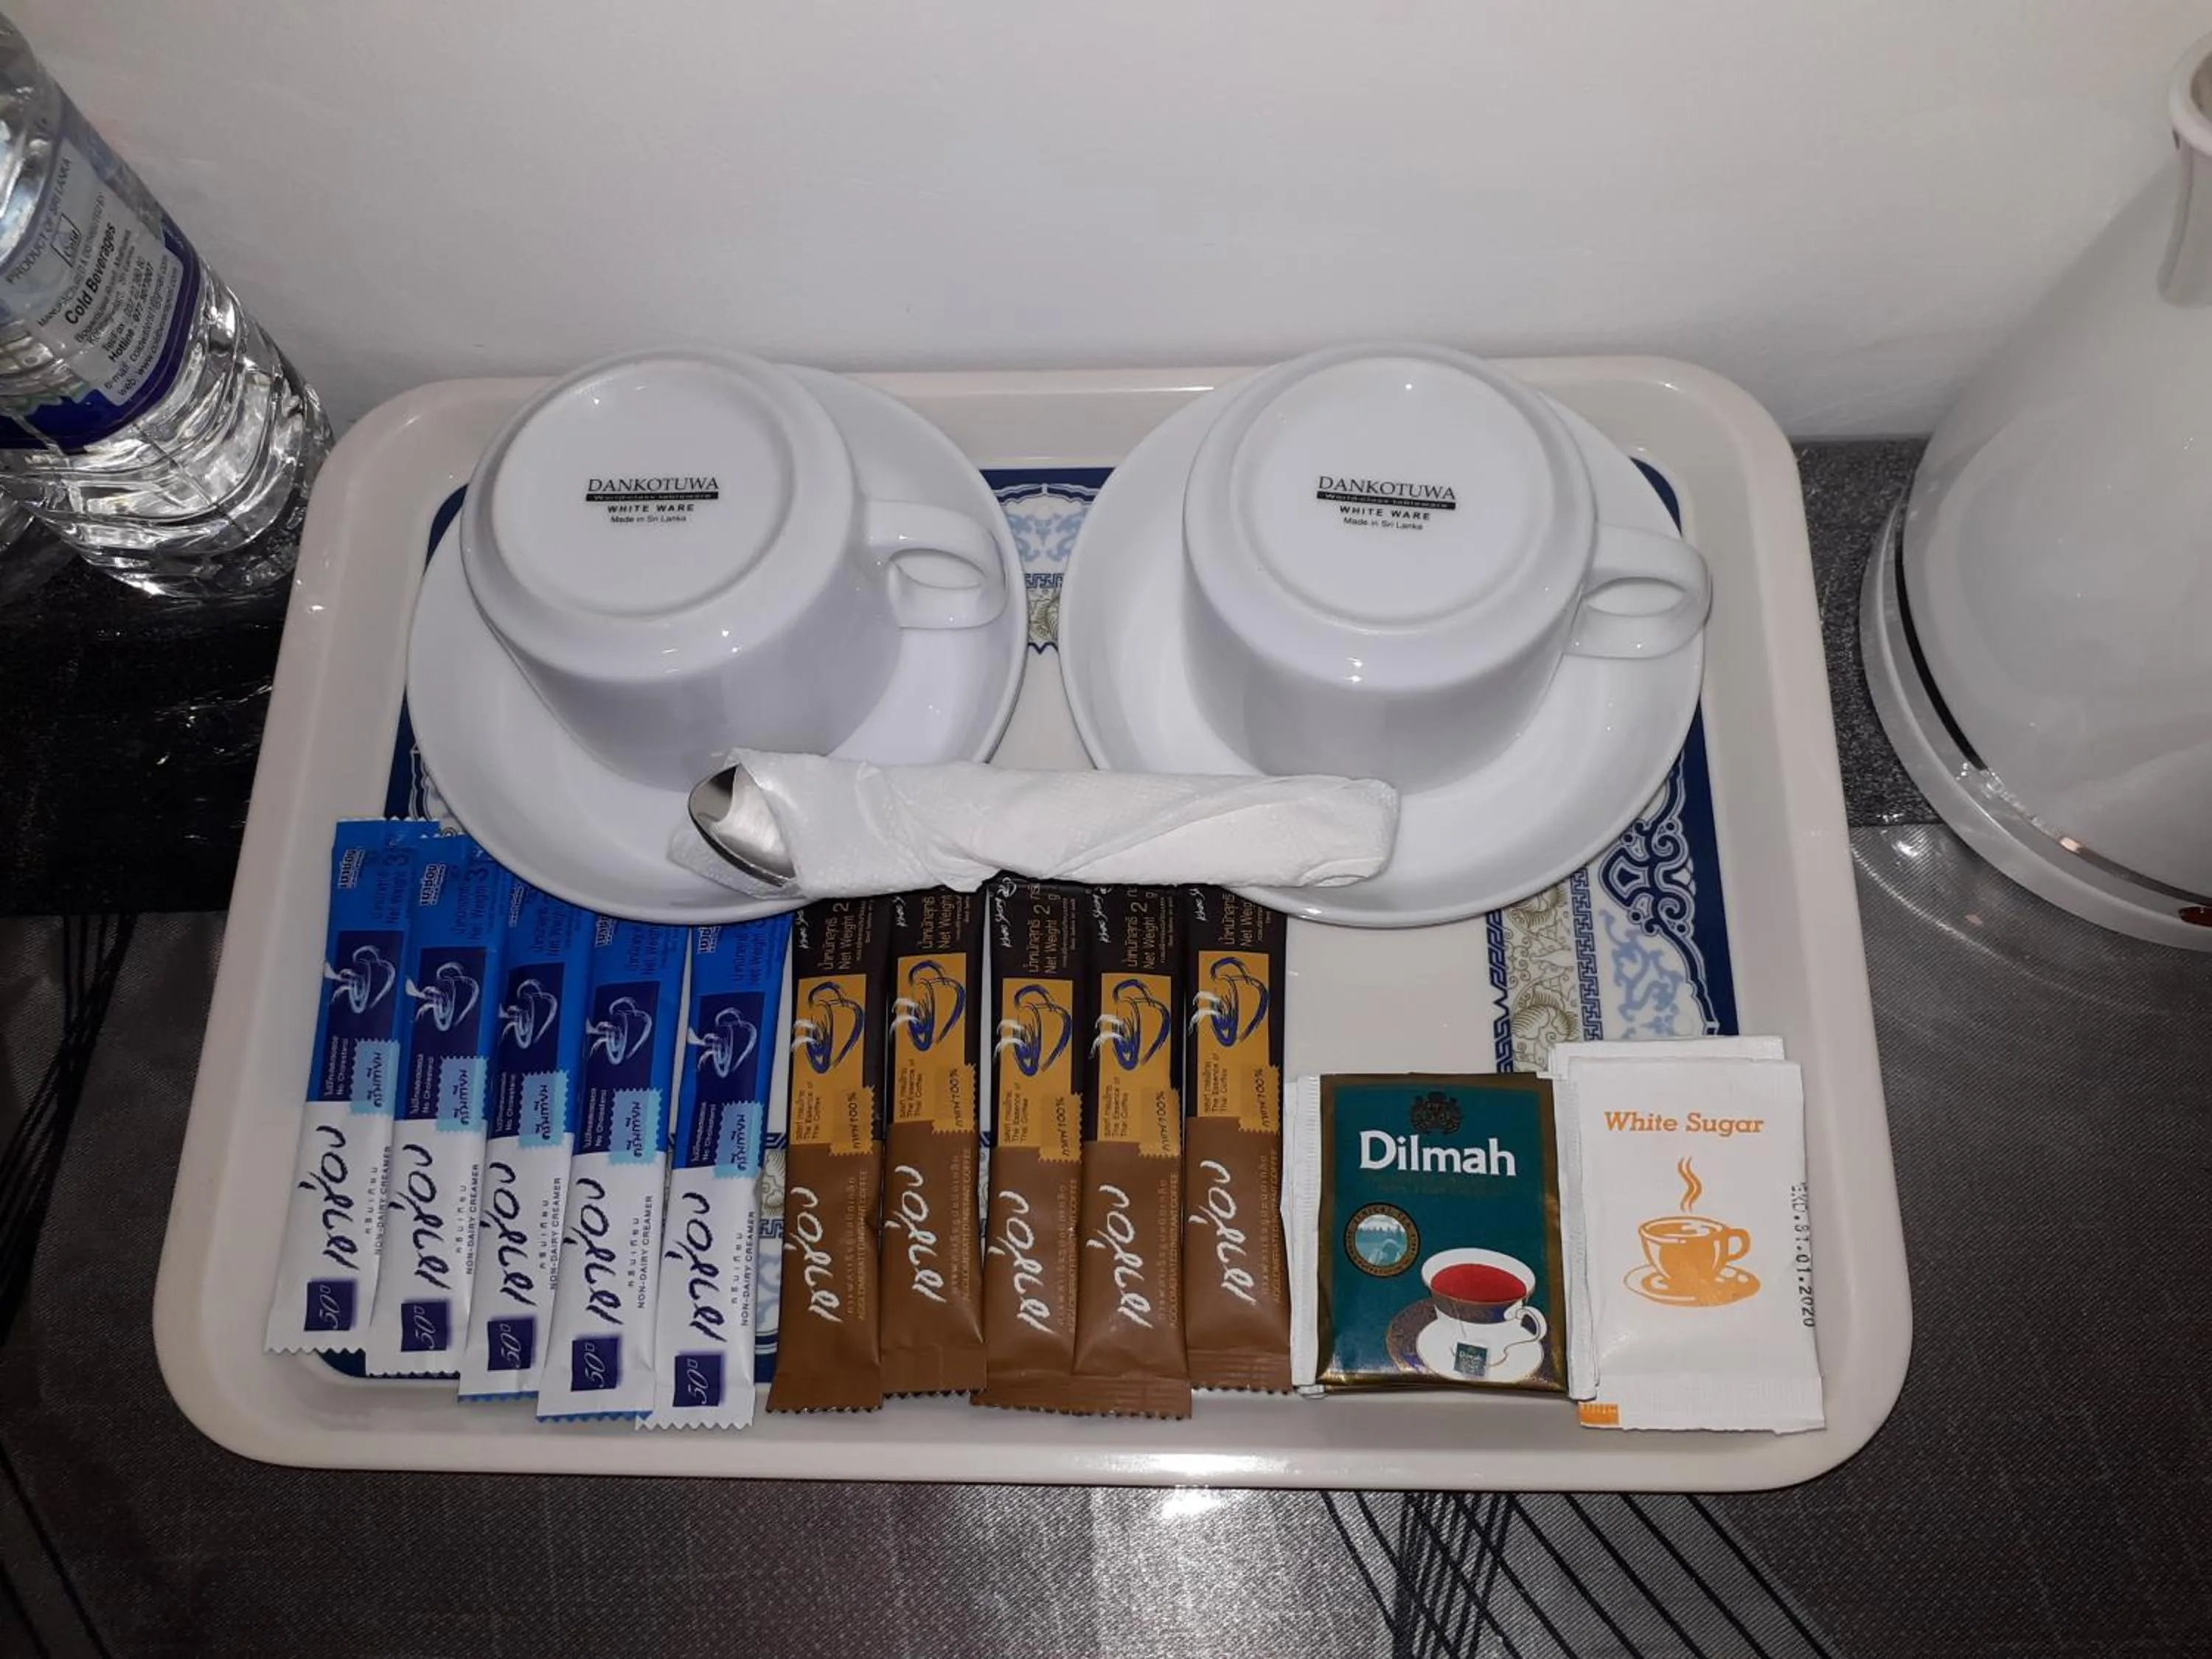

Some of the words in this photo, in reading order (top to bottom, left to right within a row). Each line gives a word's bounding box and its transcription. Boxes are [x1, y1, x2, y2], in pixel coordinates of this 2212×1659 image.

[63, 289, 93, 324] Cold
[83, 222, 116, 293] Beverages
[588, 477, 719, 492] DANKOTUWA
[1318, 476, 1455, 500] DANKOTUWA
[608, 505, 650, 513] WHITE
[1340, 506, 1383, 516] WHITE
[1391, 510, 1430, 521] WARE
[1343, 517, 1368, 526] Made
[832, 902, 849, 911] 2
[938, 895, 954, 928] Weight
[1033, 905, 1050, 914] 2
[1130, 902, 1147, 912] 2
[840, 916, 855, 948] Weight
[938, 931, 950, 949] Net
[1046, 919, 1060, 951] Weight
[1143, 917, 1158, 948] Weight
[1239, 930, 1252, 945] Net
[838, 953, 852, 970] Net
[1044, 956, 1057, 973] Net
[1143, 952, 1155, 968] Net
[1604, 1111, 1677, 1133] White
[1686, 1113, 1764, 1137] Sugar
[1360, 1130, 1517, 1177] Dilmah
[380, 1146, 391, 1194] CREAMER
[469, 1164, 479, 1214] CREAMER
[552, 1178, 562, 1228] CREAMER
[375, 1197, 387, 1256] NON-DAIRY
[641, 1195, 653, 1245] CREAMER
[466, 1217, 477, 1274] NON-DAIRY
[745, 1212, 755, 1261] CREAMER
[549, 1231, 559, 1290] NON-DAIRY
[638, 1249, 648, 1308] NON-DAIRY
[740, 1265, 752, 1326] NON-DAIRY
